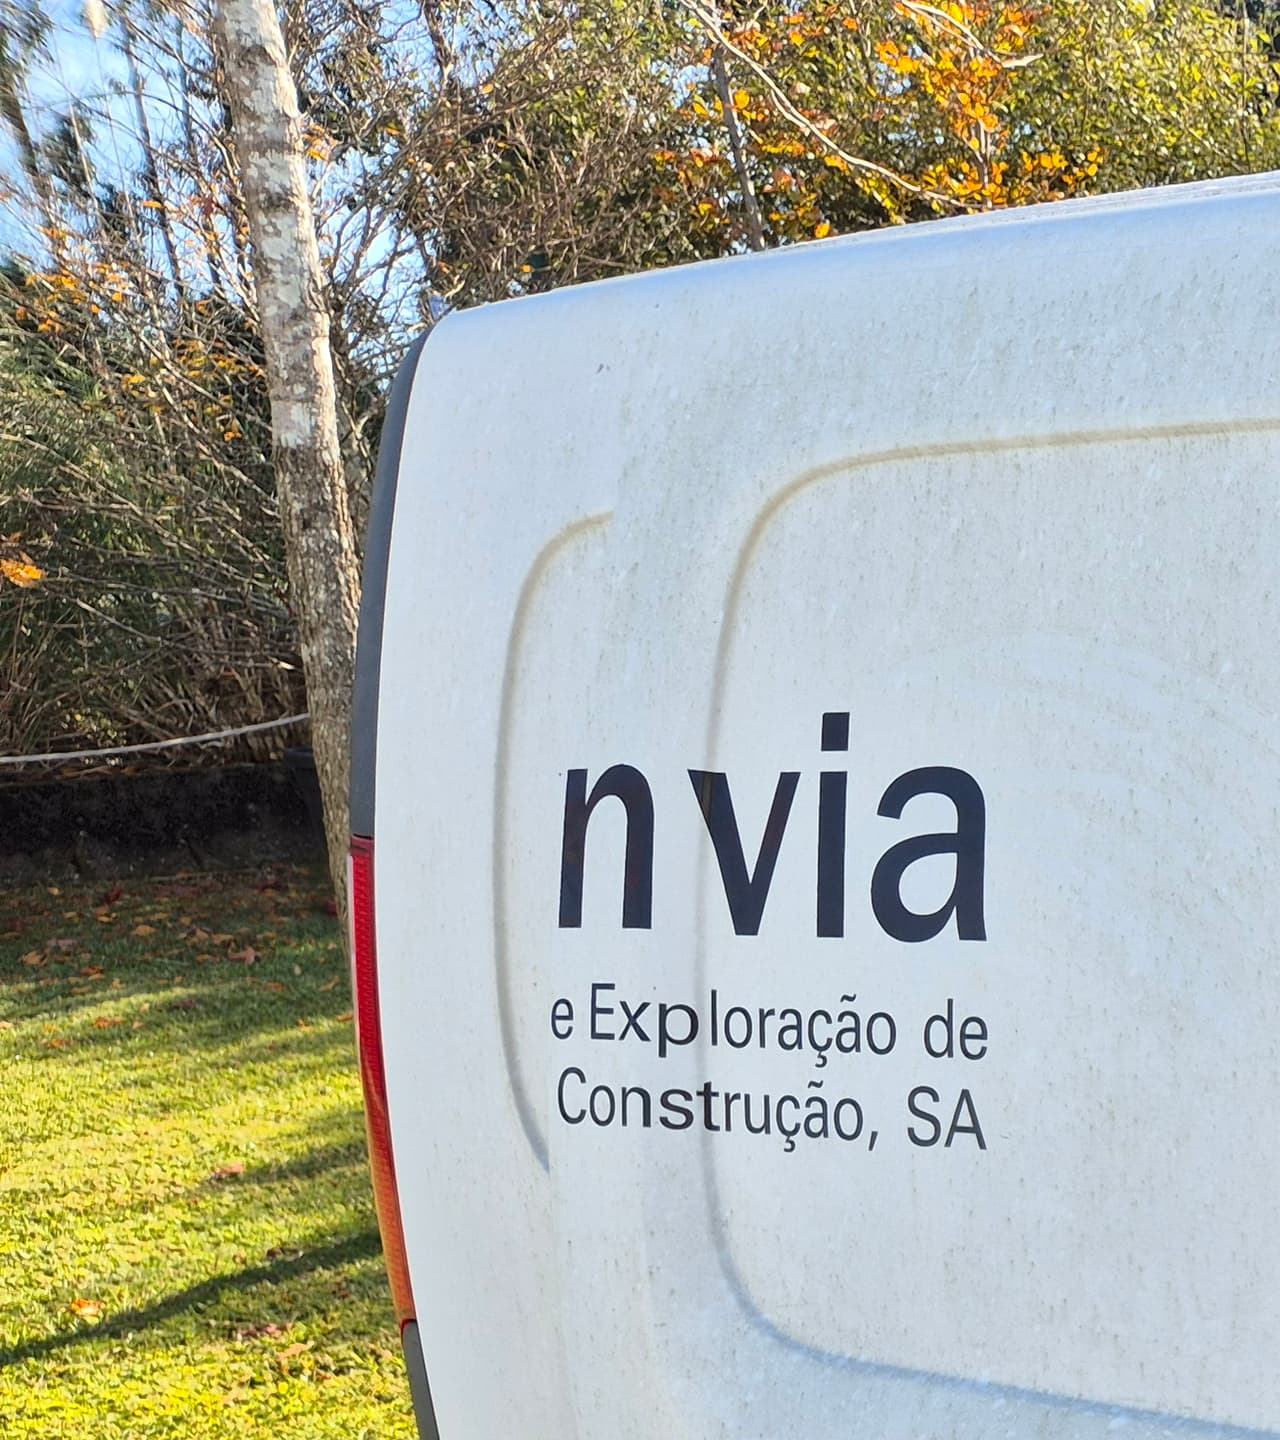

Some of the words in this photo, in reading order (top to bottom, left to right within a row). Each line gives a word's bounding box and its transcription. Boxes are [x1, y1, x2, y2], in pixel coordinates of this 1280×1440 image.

[550, 997, 575, 1040] e
[590, 982, 898, 1068] Exploração
[923, 997, 989, 1061] de
[556, 1066, 879, 1153] Construção,
[906, 1085, 988, 1150] SA
